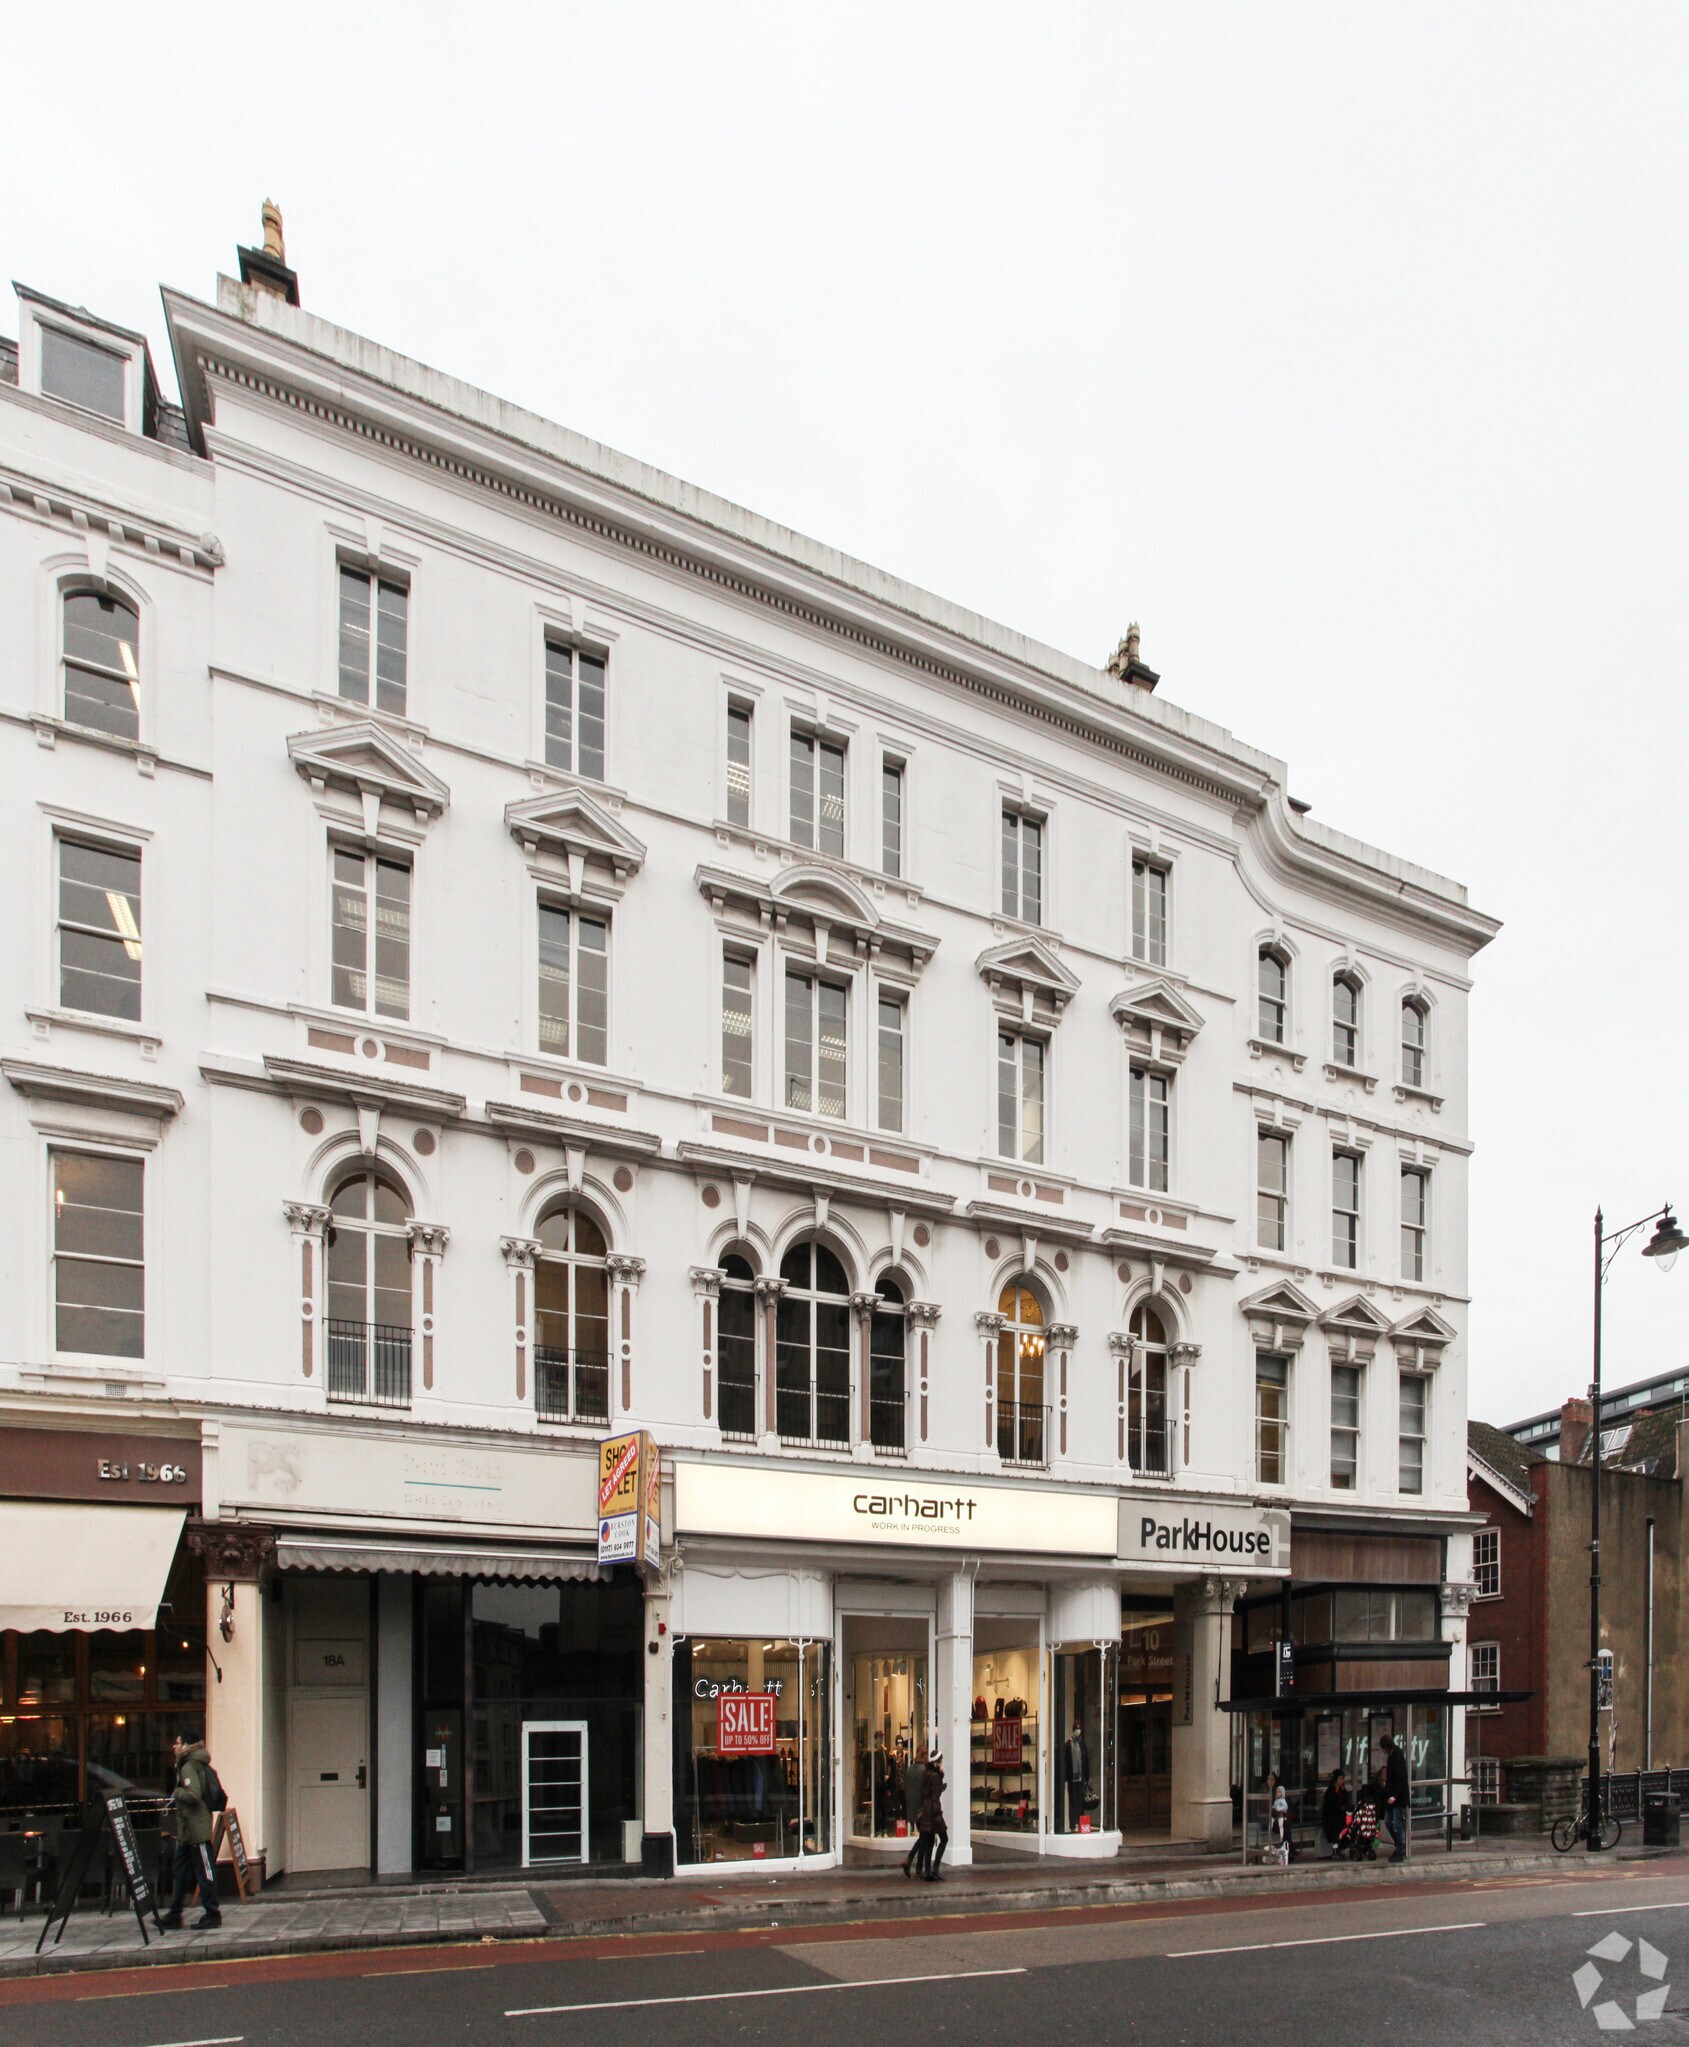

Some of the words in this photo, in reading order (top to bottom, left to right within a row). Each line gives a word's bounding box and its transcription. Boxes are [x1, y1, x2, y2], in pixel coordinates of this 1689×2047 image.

[98, 1459, 129, 1479] Est
[138, 1462, 187, 1483] 1966
[612, 1445, 636, 1486] AGREED
[853, 1494, 978, 1520] carhartt
[611, 1519, 635, 1531] BURSTON
[872, 1522, 899, 1531] WORK
[912, 1525, 961, 1534] PROGRESS
[1141, 1517, 1270, 1554] ParkHouse
[63, 1611, 91, 1623] Est.
[94, 1611, 132, 1623] 1966
[1142, 1629, 1160, 1651] 10
[322, 1654, 345, 1667] 18A
[1127, 1655, 1145, 1666] Park
[1149, 1655, 1174, 1667] Street
[725, 1702, 769, 1732] SALE
[724, 1735, 734, 1745] UP
[735, 1735, 743, 1745] TO
[743, 1735, 758, 1745] 50%
[760, 1734, 770, 1745] OFF
[995, 1725, 1018, 1750] SALE
